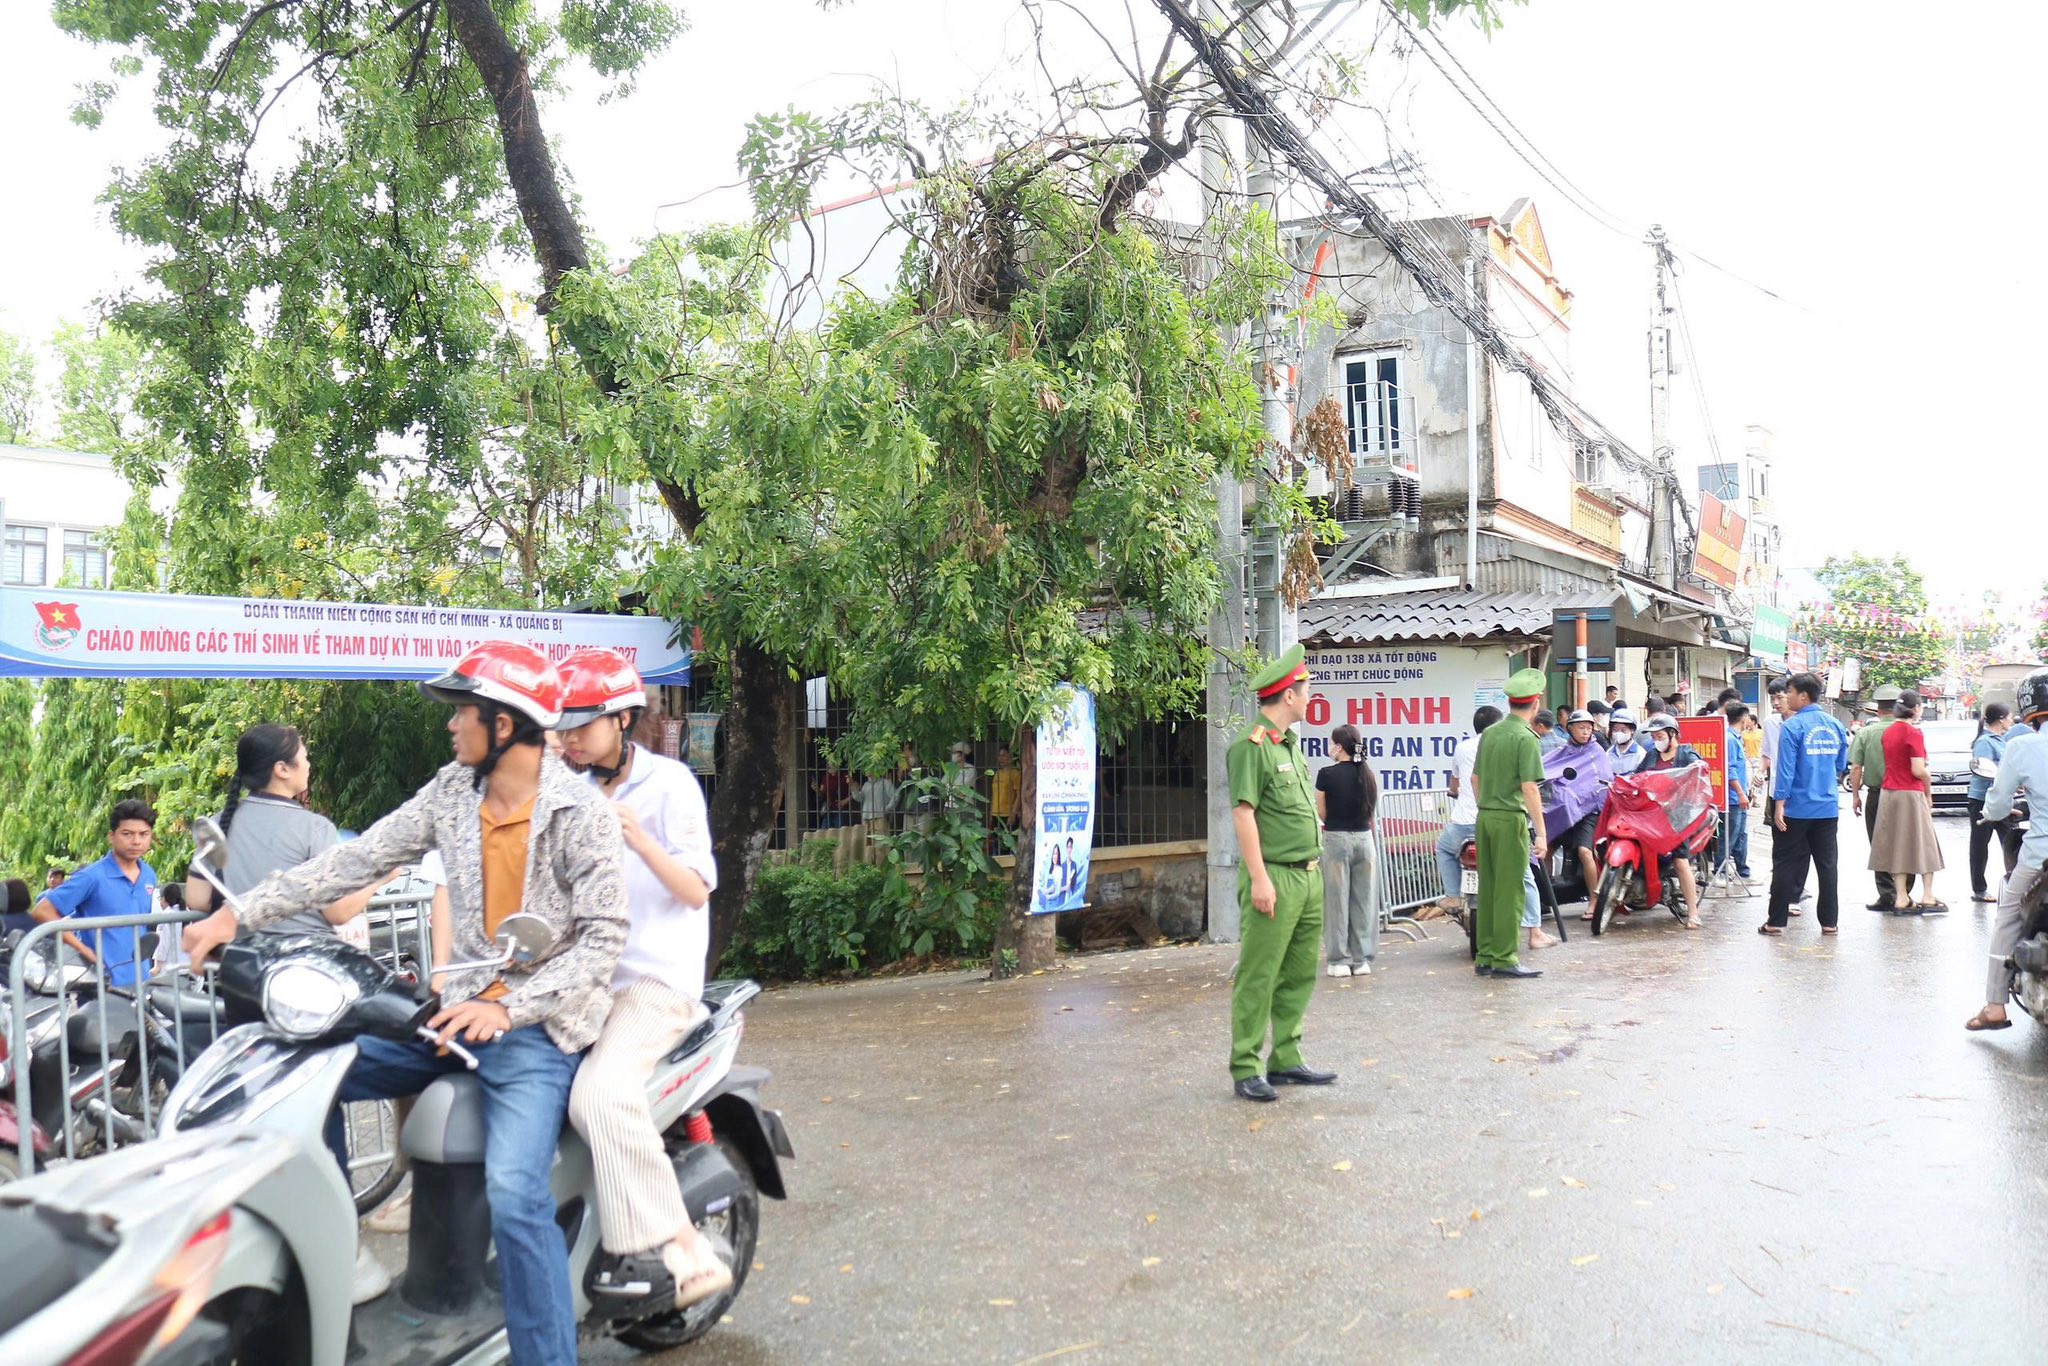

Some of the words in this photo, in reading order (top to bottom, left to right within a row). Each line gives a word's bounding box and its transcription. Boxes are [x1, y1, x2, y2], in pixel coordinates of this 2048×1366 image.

[244, 602, 279, 618] ĐOÀN
[283, 605, 324, 621] THANH
[328, 606, 357, 622] NIÊN
[360, 607, 391, 626] CỘNG
[395, 608, 419, 624] SẢN
[440, 611, 459, 626] CHÍ
[461, 614, 489, 627] MINH
[499, 614, 513, 628] XÃ
[516, 614, 550, 630] QUẢNG
[552, 618, 562, 634] BỊ
[86, 625, 134, 651] CHÀO
[140, 626, 190, 652] MỪNG
[196, 627, 228, 653] CÁC
[233, 628, 257, 653] THÍ
[262, 633, 298, 654] SINH
[325, 635, 365, 655] THAM
[370, 635, 389, 660] DỰ
[392, 634, 409, 656] KỲ
[413, 638, 433, 657] THI
[437, 635, 461, 658] VÀO
[1321, 654, 1343, 667] ĐẠO
[1346, 655, 1365, 664] 138
[1367, 652, 1382, 664] XÃ
[1385, 650, 1404, 663] TỐT
[1406, 650, 1437, 665] ĐỘNG
[1333, 670, 1359, 680] THPT
[1362, 668, 1391, 680] CHÚC
[1393, 667, 1424, 681] ĐỘNG
[1306, 692, 1331, 726] Ô
[1346, 692, 1451, 725] HÌNH
[1391, 737, 1423, 757] AN
